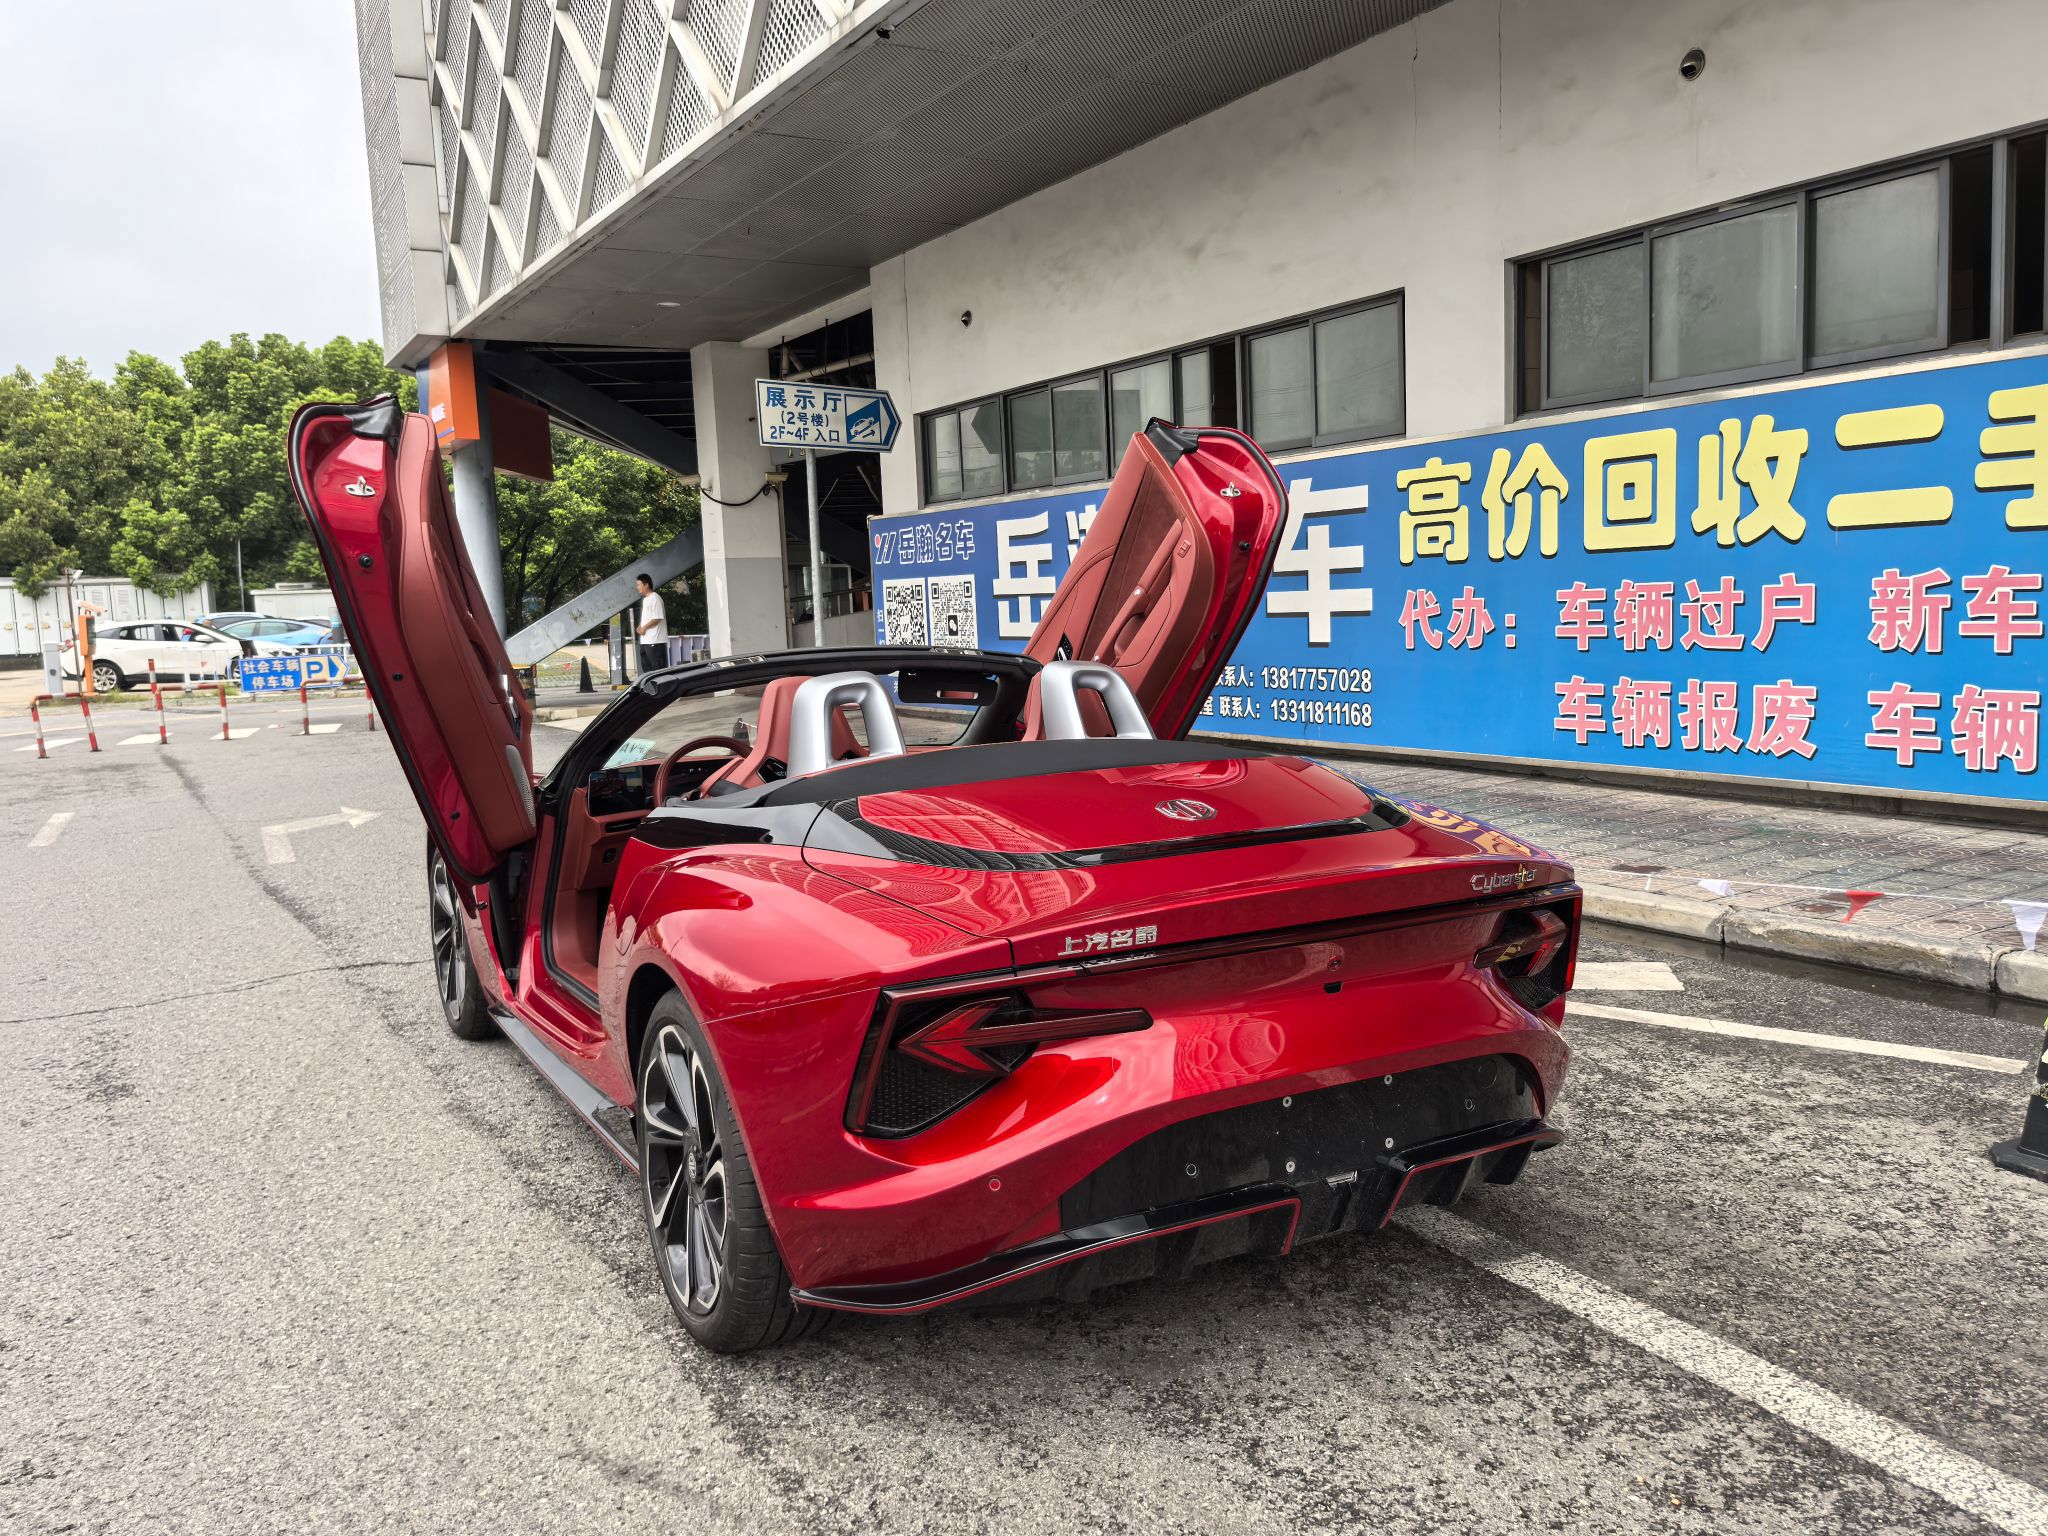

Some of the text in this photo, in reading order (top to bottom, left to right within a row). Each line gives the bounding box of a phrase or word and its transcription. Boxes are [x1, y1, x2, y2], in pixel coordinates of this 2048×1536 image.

[766, 386, 842, 412] 展示厅
[781, 411, 829, 428] (2号楼)
[770, 426, 840, 443] 2F~4F 入口
[898, 520, 976, 565] 岳瀚名车
[1398, 564, 2044, 654] 代办： 车辆过户 新车
[242, 659, 324, 679] 社会车辆 P
[252, 675, 295, 689] 停车场
[1261, 666, 1373, 693] 13817757028
[1270, 698, 1373, 728] 13311811168
[1554, 675, 2041, 773] 车辆报废 车辆
[1057, 924, 1159, 956] 上汽名爵
